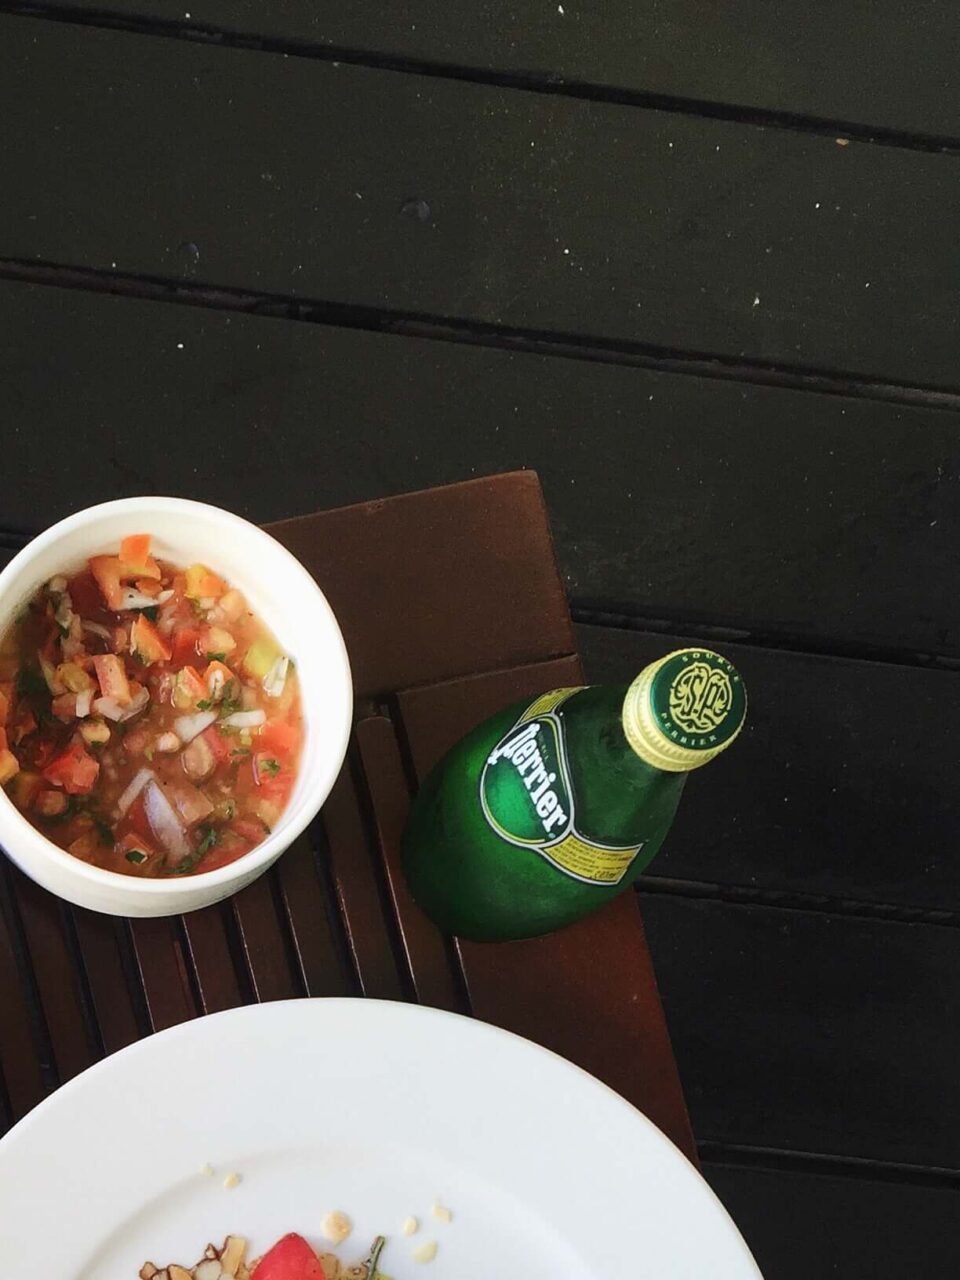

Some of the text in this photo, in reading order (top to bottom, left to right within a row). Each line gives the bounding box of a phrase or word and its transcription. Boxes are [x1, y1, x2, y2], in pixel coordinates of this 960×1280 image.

[681, 652, 740, 682] SOURCE
[661, 712, 717, 746] PERRIER
[487, 723, 568, 833] Perrier
